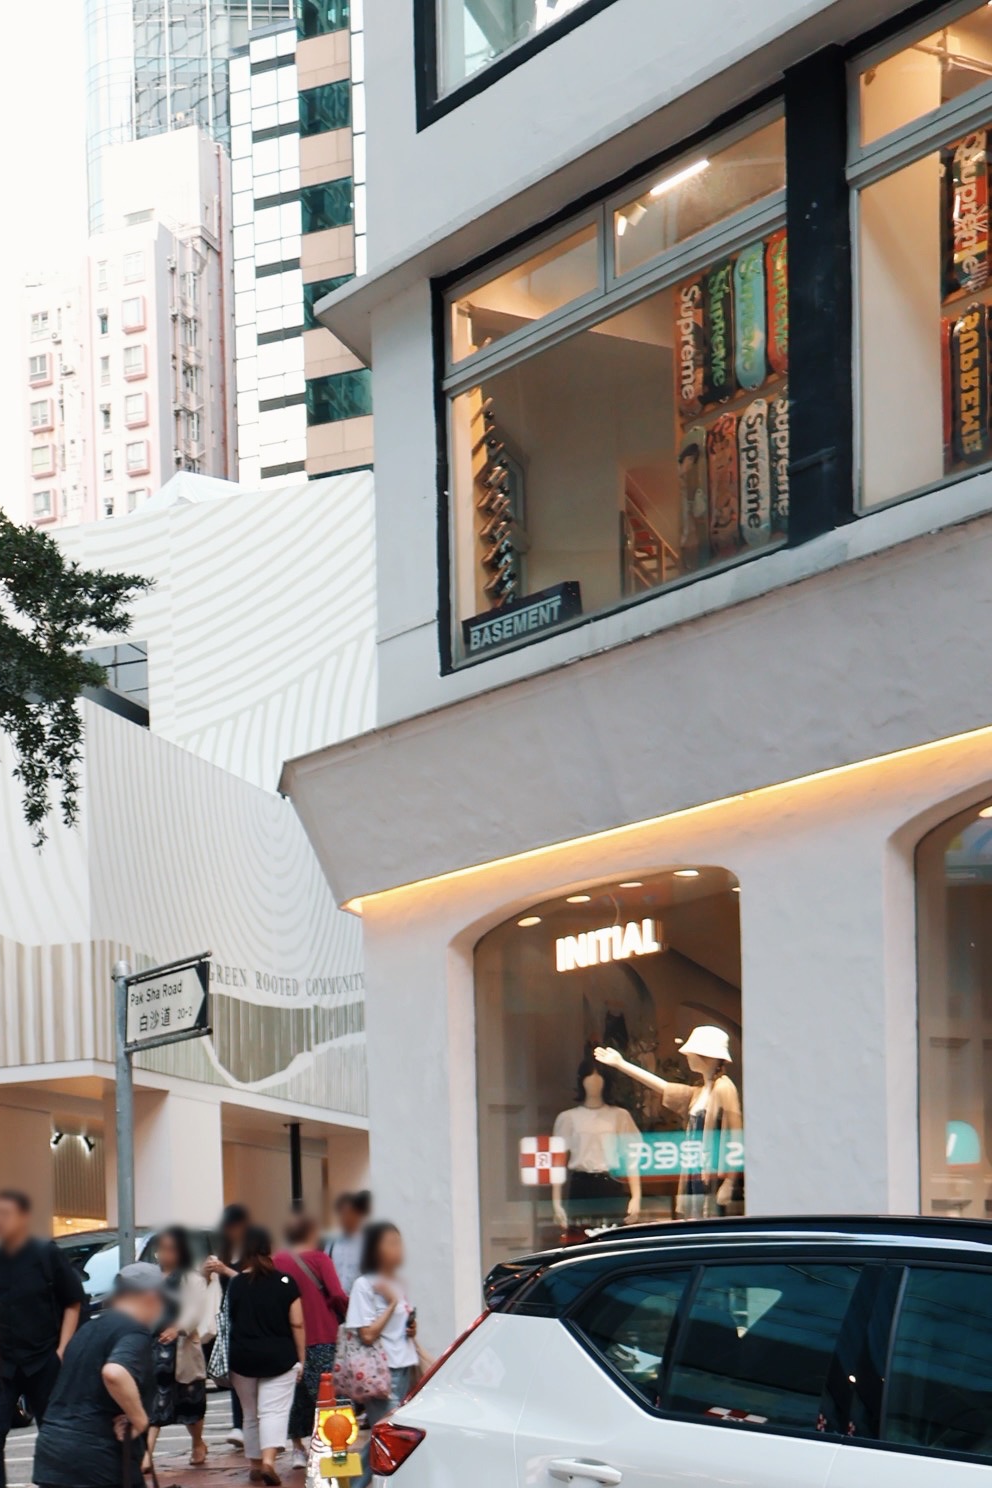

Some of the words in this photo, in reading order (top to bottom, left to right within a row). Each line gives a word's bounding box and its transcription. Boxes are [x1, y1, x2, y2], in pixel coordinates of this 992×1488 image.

[676, 284, 701, 400] Supreme
[739, 413, 765, 529] Supreme
[470, 601, 562, 650] BASEMENT
[555, 918, 660, 972] INITIAL
[130, 993, 144, 1007] Pak
[146, 987, 160, 1002] Sha
[162, 980, 183, 998] Road
[209, 961, 248, 988] GREEN
[256, 971, 299, 997] ROOTED
[305, 972, 365, 996] COMMUNITY
[139, 1005, 171, 1032] 白沙道
